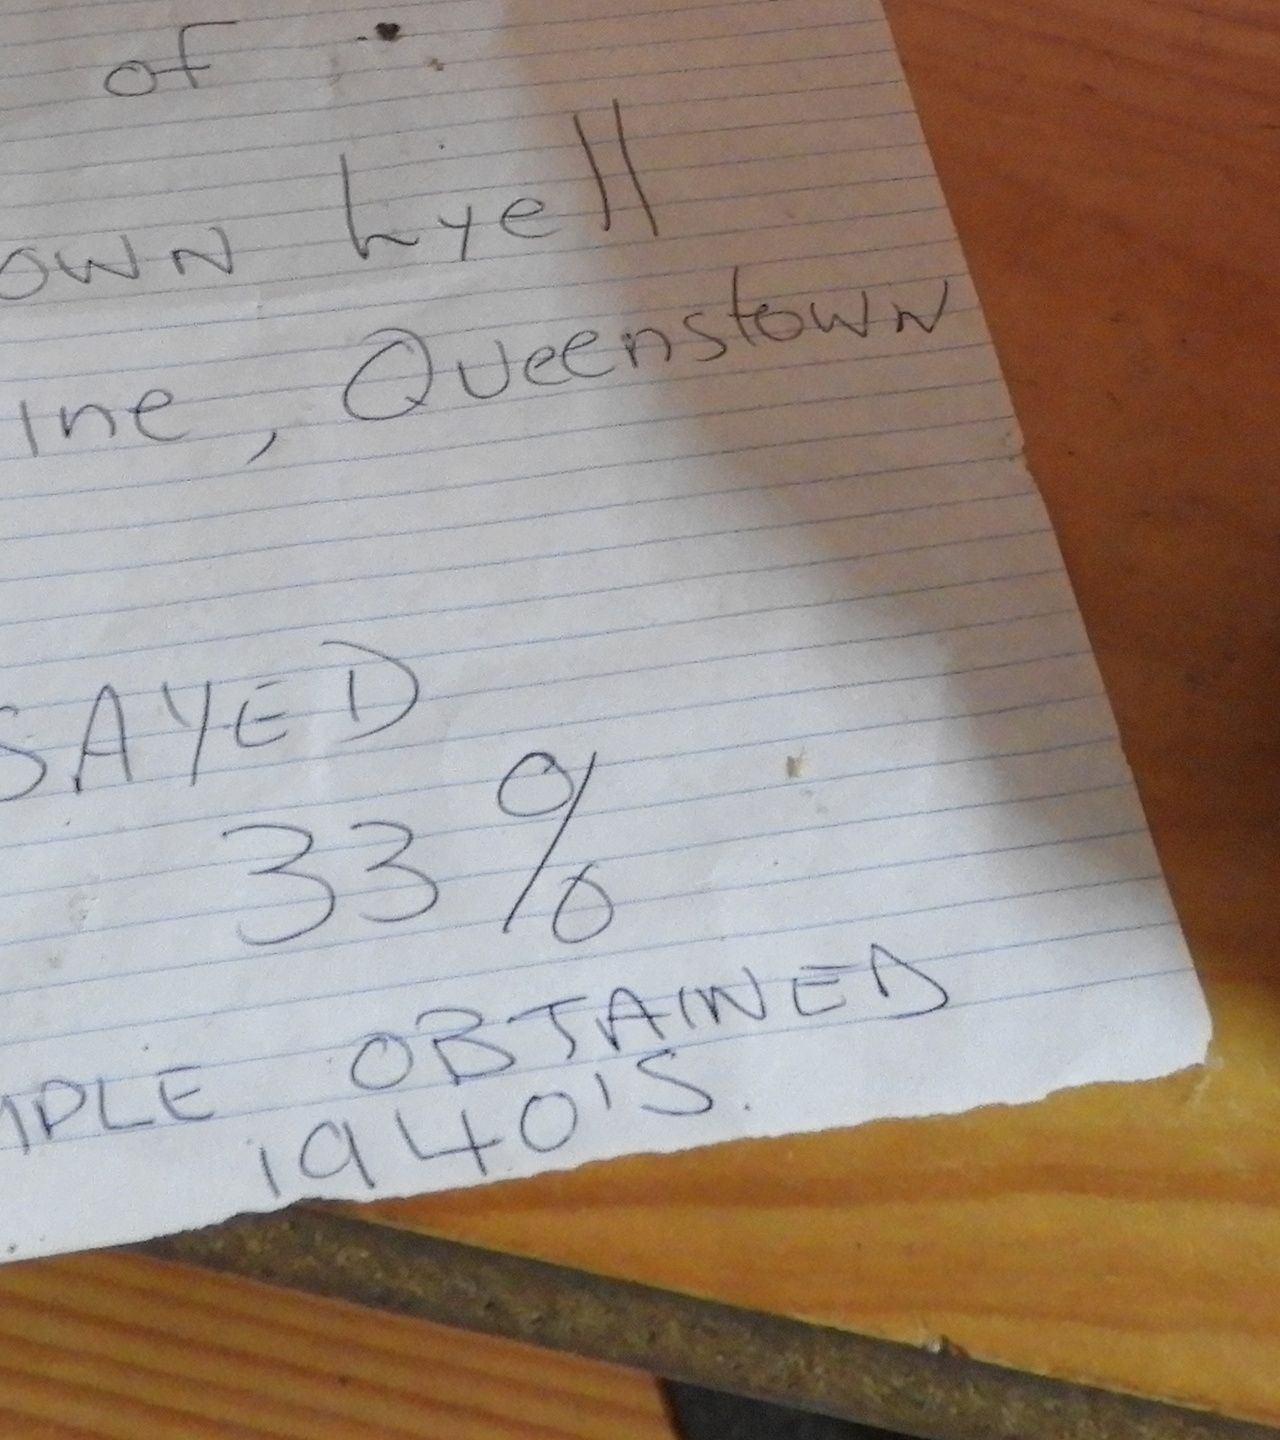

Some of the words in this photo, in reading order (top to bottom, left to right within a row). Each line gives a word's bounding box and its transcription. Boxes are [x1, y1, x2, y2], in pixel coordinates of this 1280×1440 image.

[105, 20, 239, 97] of
[340, 98, 658, 260] Lyell
[341, 266, 950, 421] Queenstown
[350, 943, 950, 1090] OBTAINED
